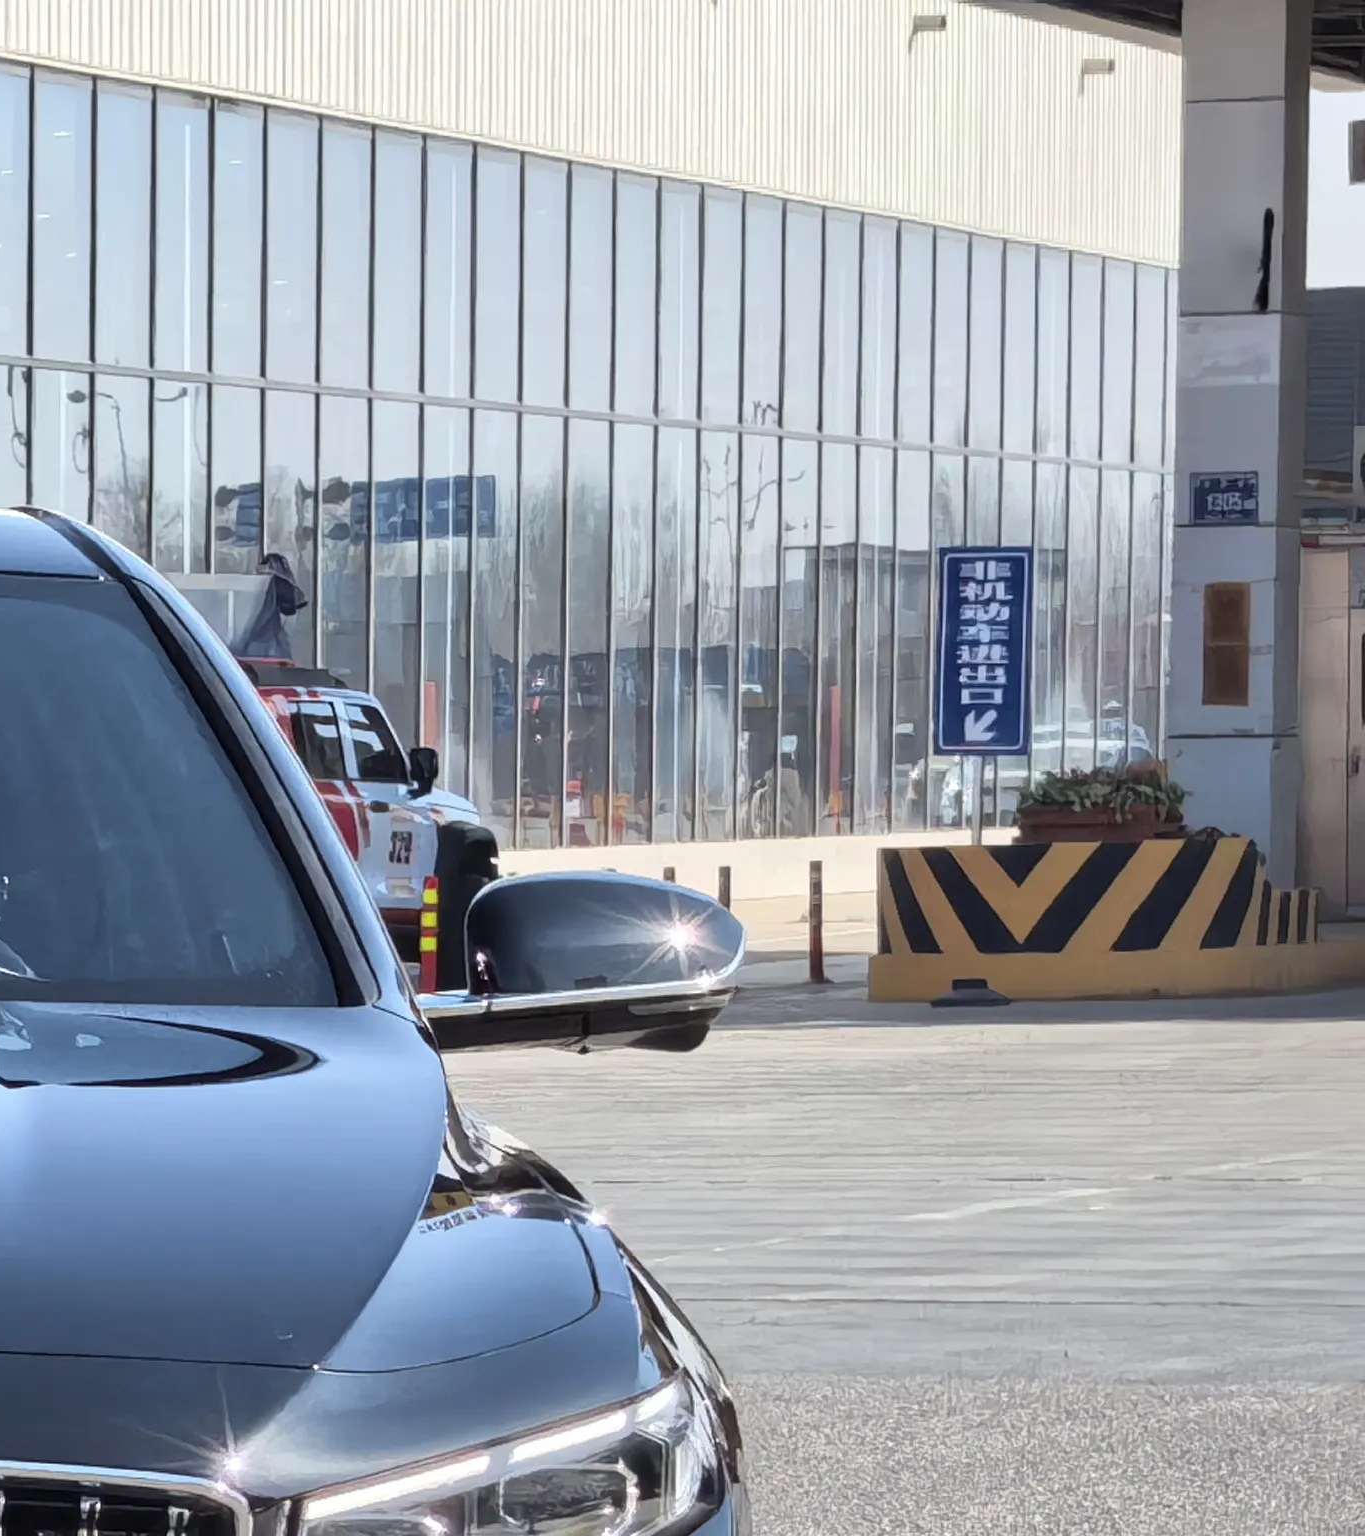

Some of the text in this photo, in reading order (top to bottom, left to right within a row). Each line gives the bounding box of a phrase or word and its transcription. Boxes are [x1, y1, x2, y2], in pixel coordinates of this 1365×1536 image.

[956, 560, 1014, 704] 非机动车进出口
